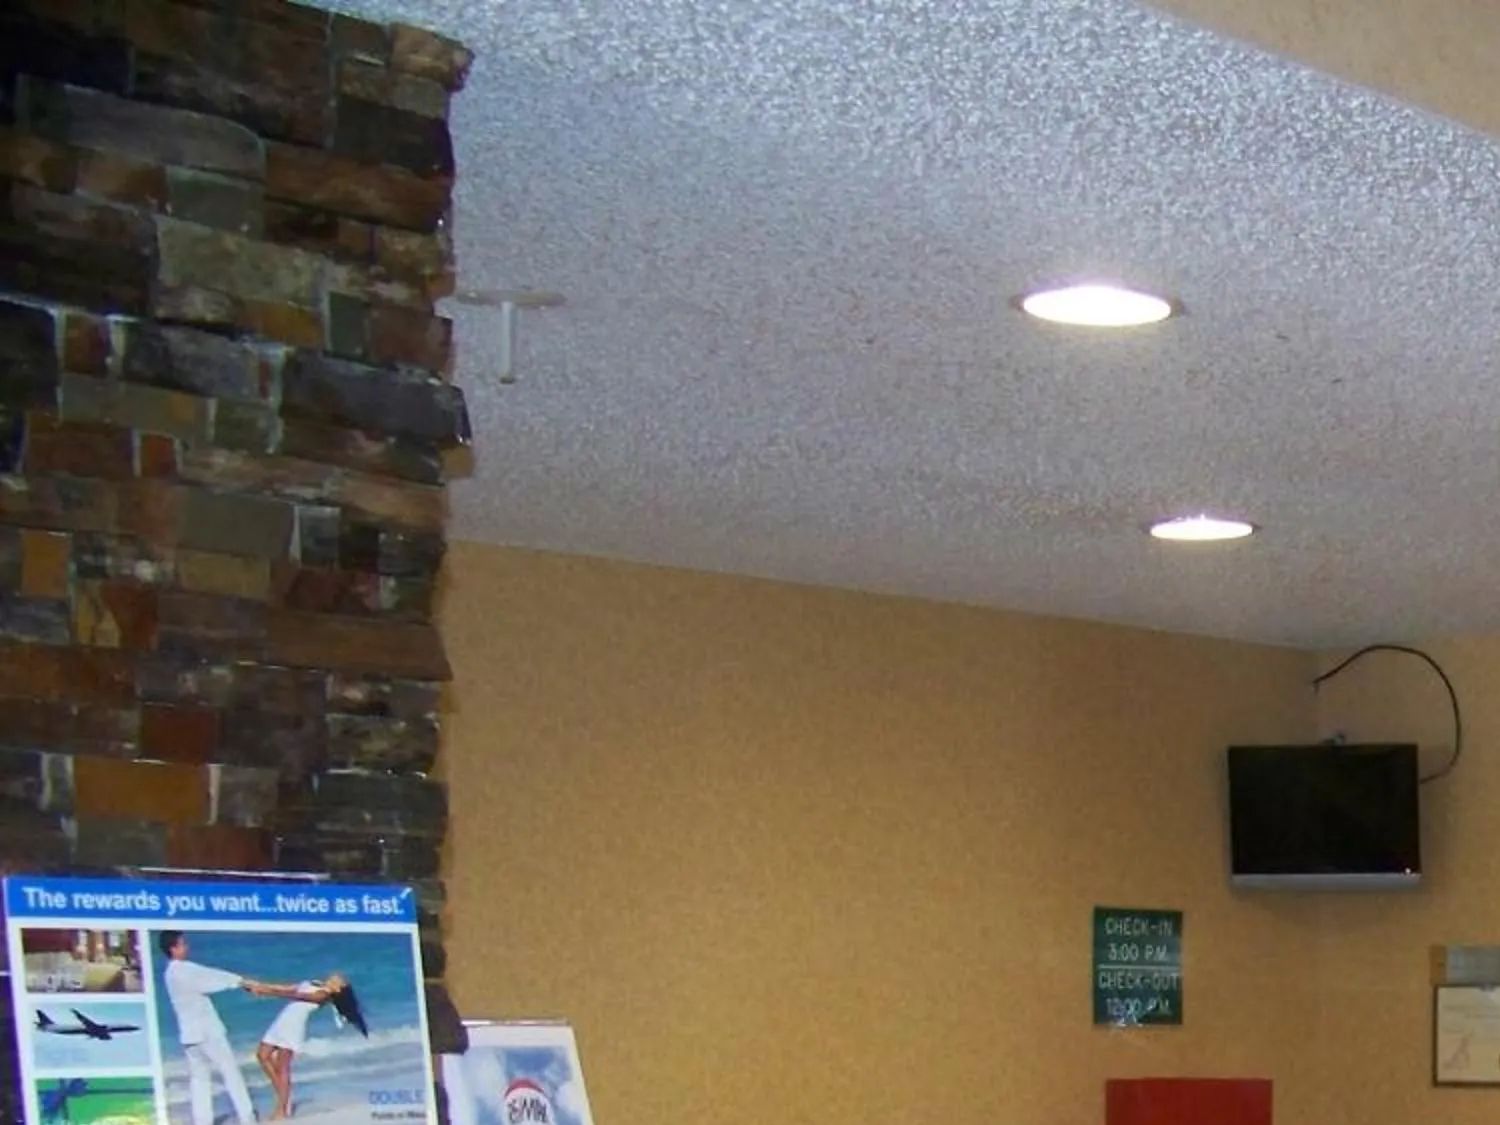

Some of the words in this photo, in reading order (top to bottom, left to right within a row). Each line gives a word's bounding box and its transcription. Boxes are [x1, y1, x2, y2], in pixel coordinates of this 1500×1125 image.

[22, 886, 67, 908] The
[72, 889, 161, 911] rewards
[166, 895, 206, 916] you
[335, 898, 358, 914] as
[1105, 917, 1173, 936] CHECK-IN
[1099, 971, 1178, 991] CHECK-OUT
